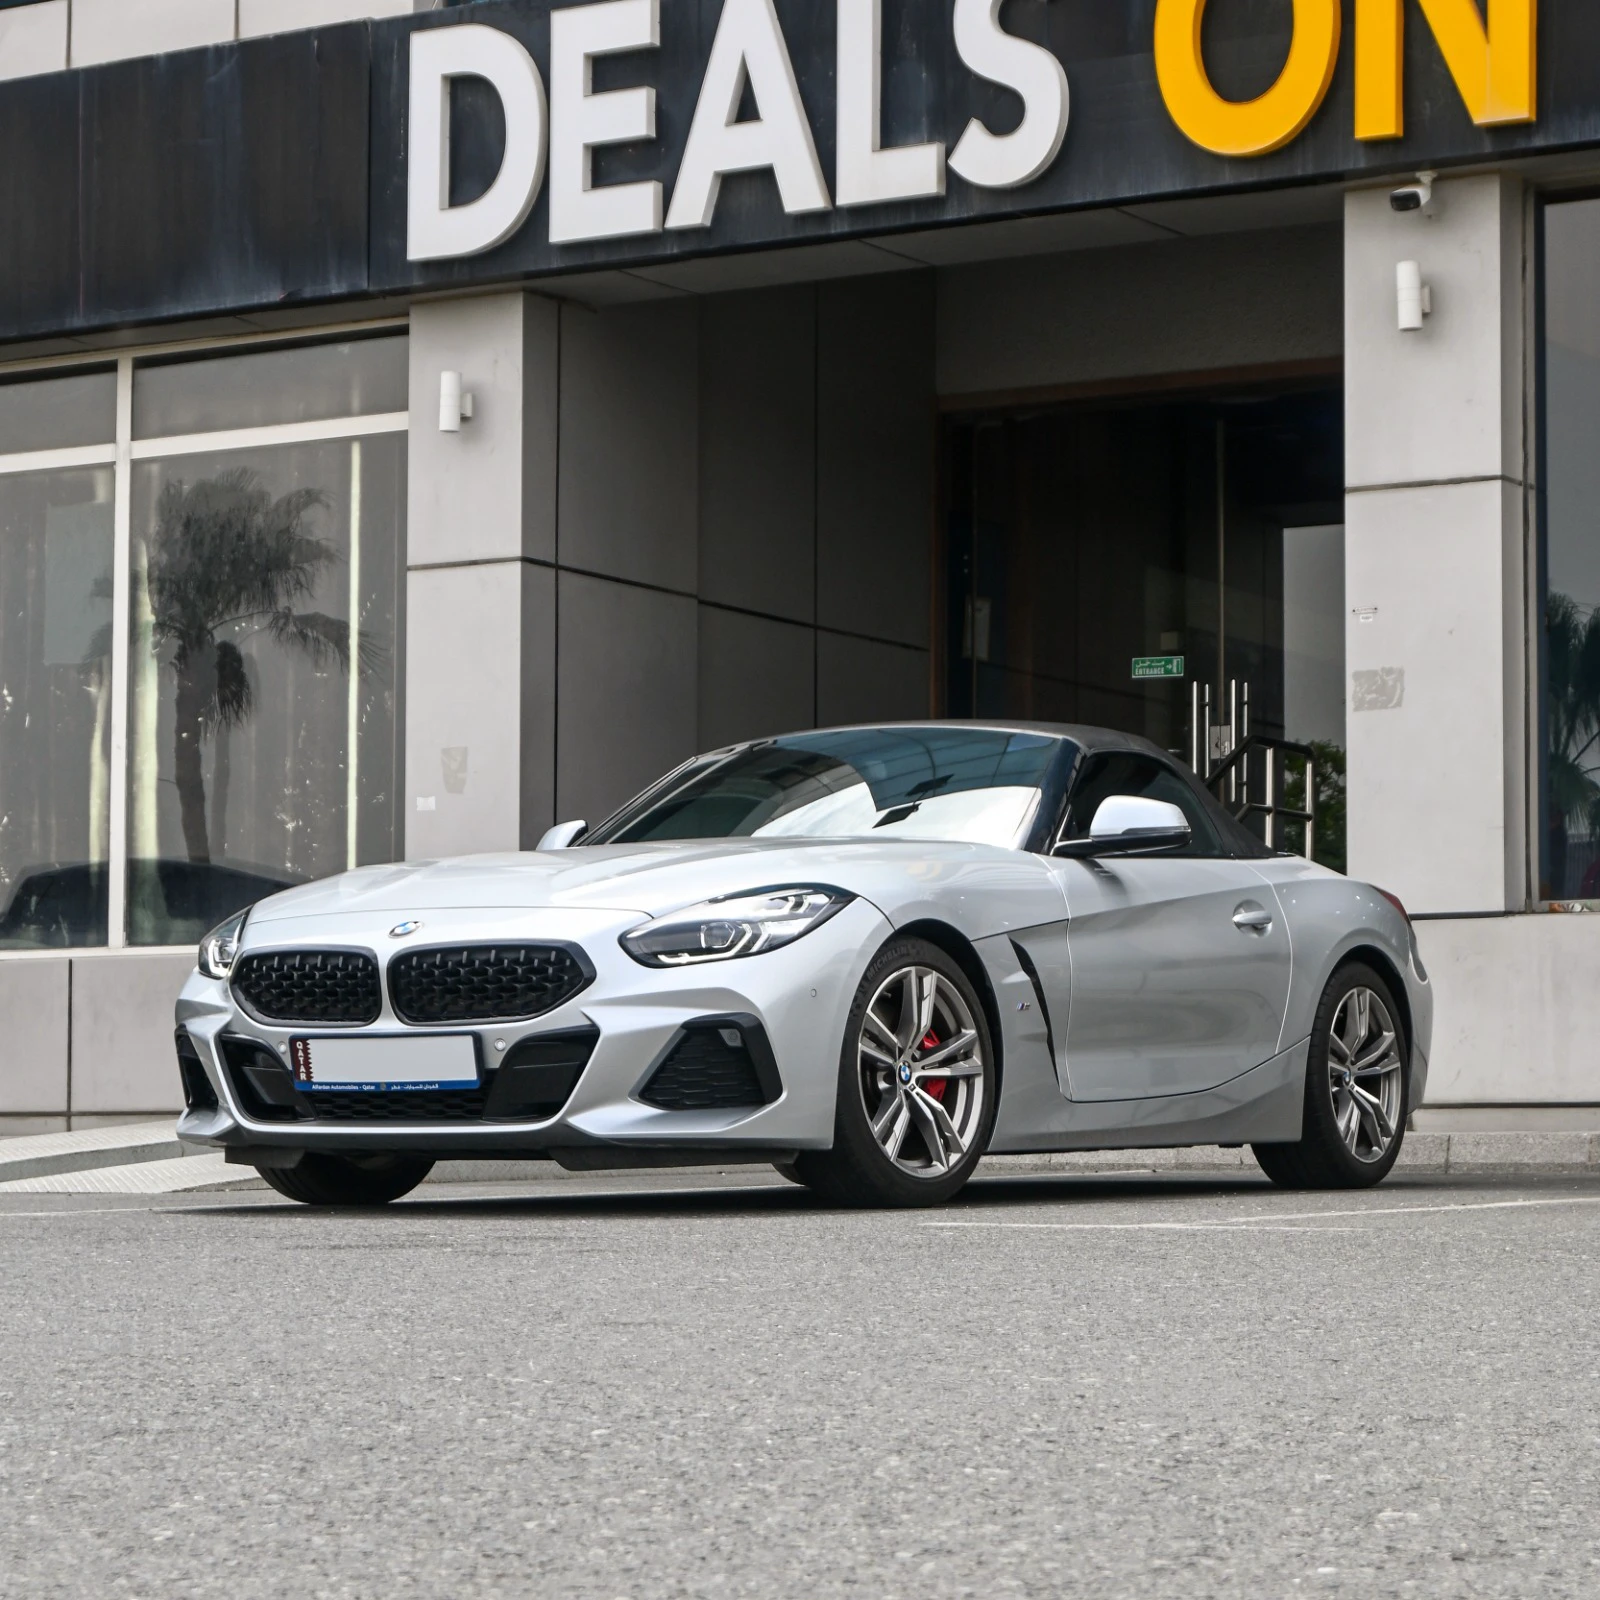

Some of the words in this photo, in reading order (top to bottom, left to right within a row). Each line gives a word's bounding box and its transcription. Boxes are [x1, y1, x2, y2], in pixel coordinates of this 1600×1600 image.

[407, 0, 1069, 262] DEALS
[1154, 0, 1537, 157] ON
[1135, 667, 1165, 675] ENTRANCE
[866, 945, 909, 979] MICHELIN
[296, 1041, 307, 1081] QATAR
